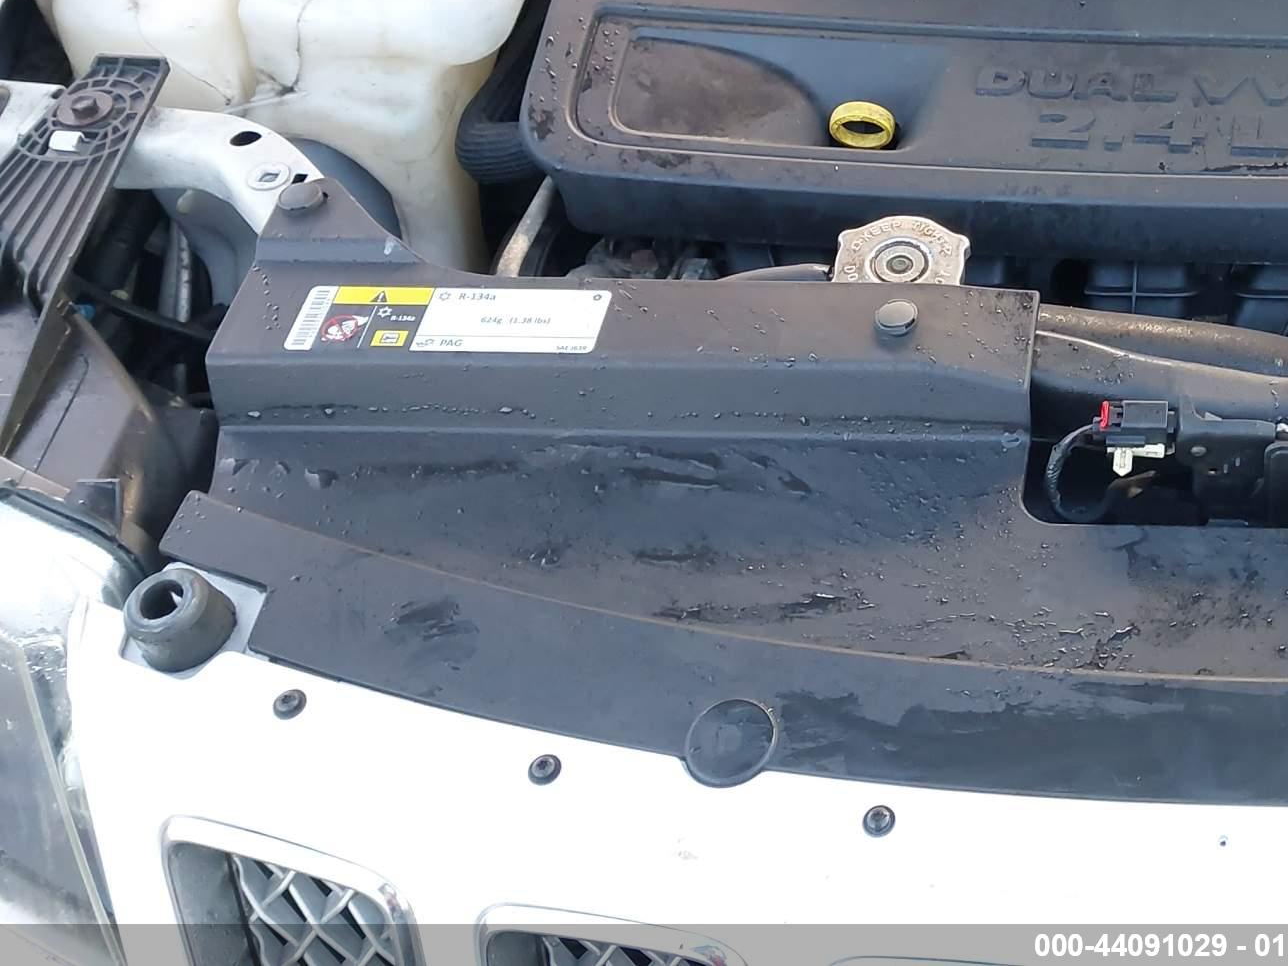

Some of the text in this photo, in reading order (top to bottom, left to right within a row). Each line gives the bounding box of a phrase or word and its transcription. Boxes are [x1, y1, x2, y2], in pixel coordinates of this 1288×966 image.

[975, 67, 1177, 103] DUAL
[458, 292, 496, 301] R-134a
[439, 338, 463, 347] PAG
